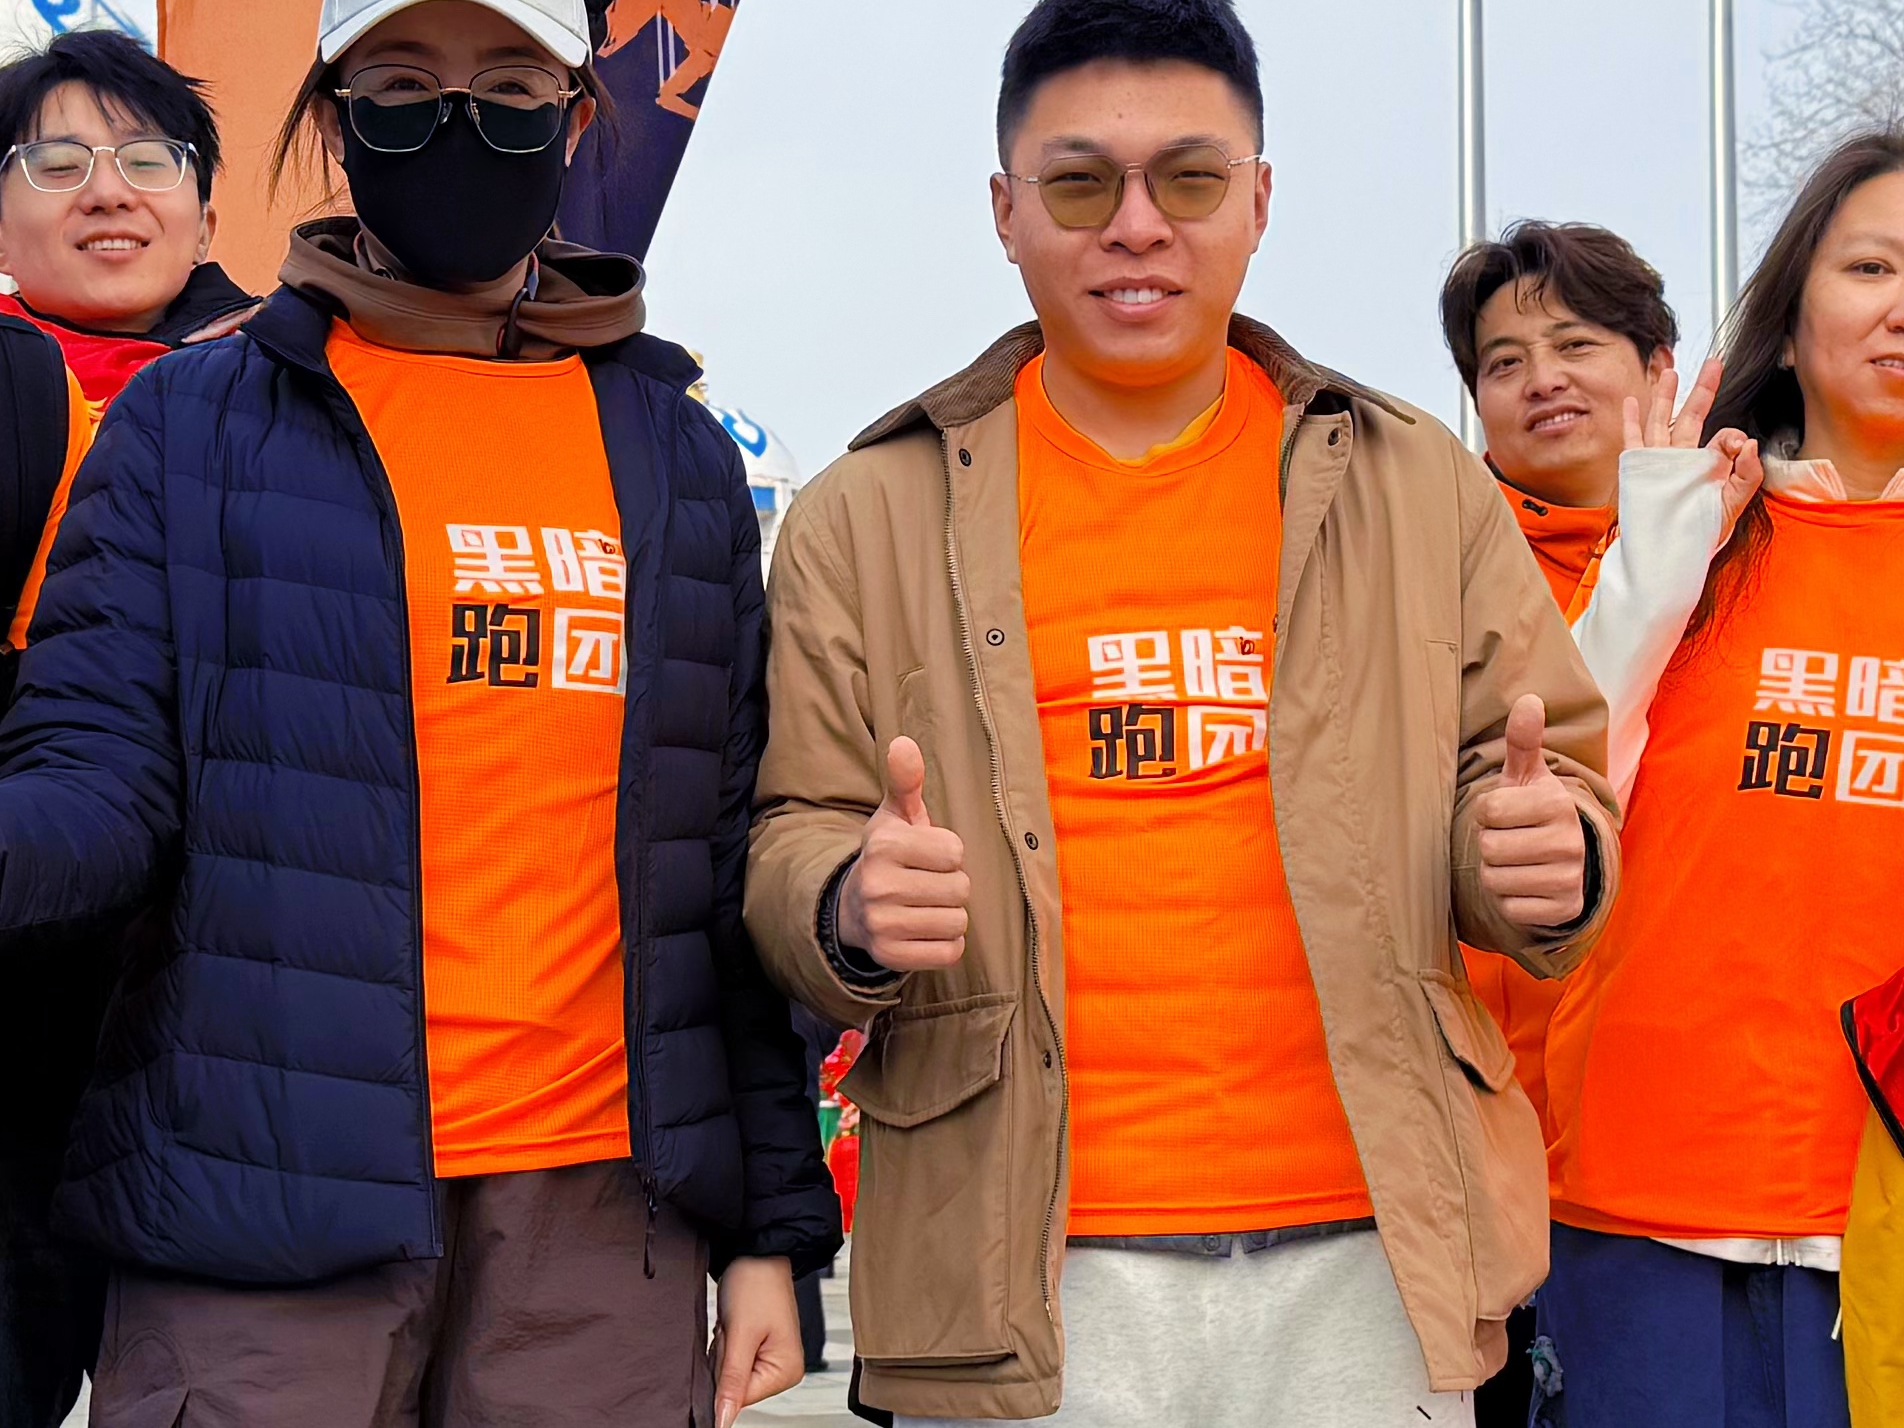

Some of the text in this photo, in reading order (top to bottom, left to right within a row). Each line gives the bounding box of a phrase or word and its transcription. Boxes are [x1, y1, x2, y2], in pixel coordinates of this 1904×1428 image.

[445, 523, 627, 600] 黑暗
[446, 603, 628, 697] 跑团
[1087, 625, 1269, 702] 黑暗
[1088, 703, 1268, 780] 跑团
